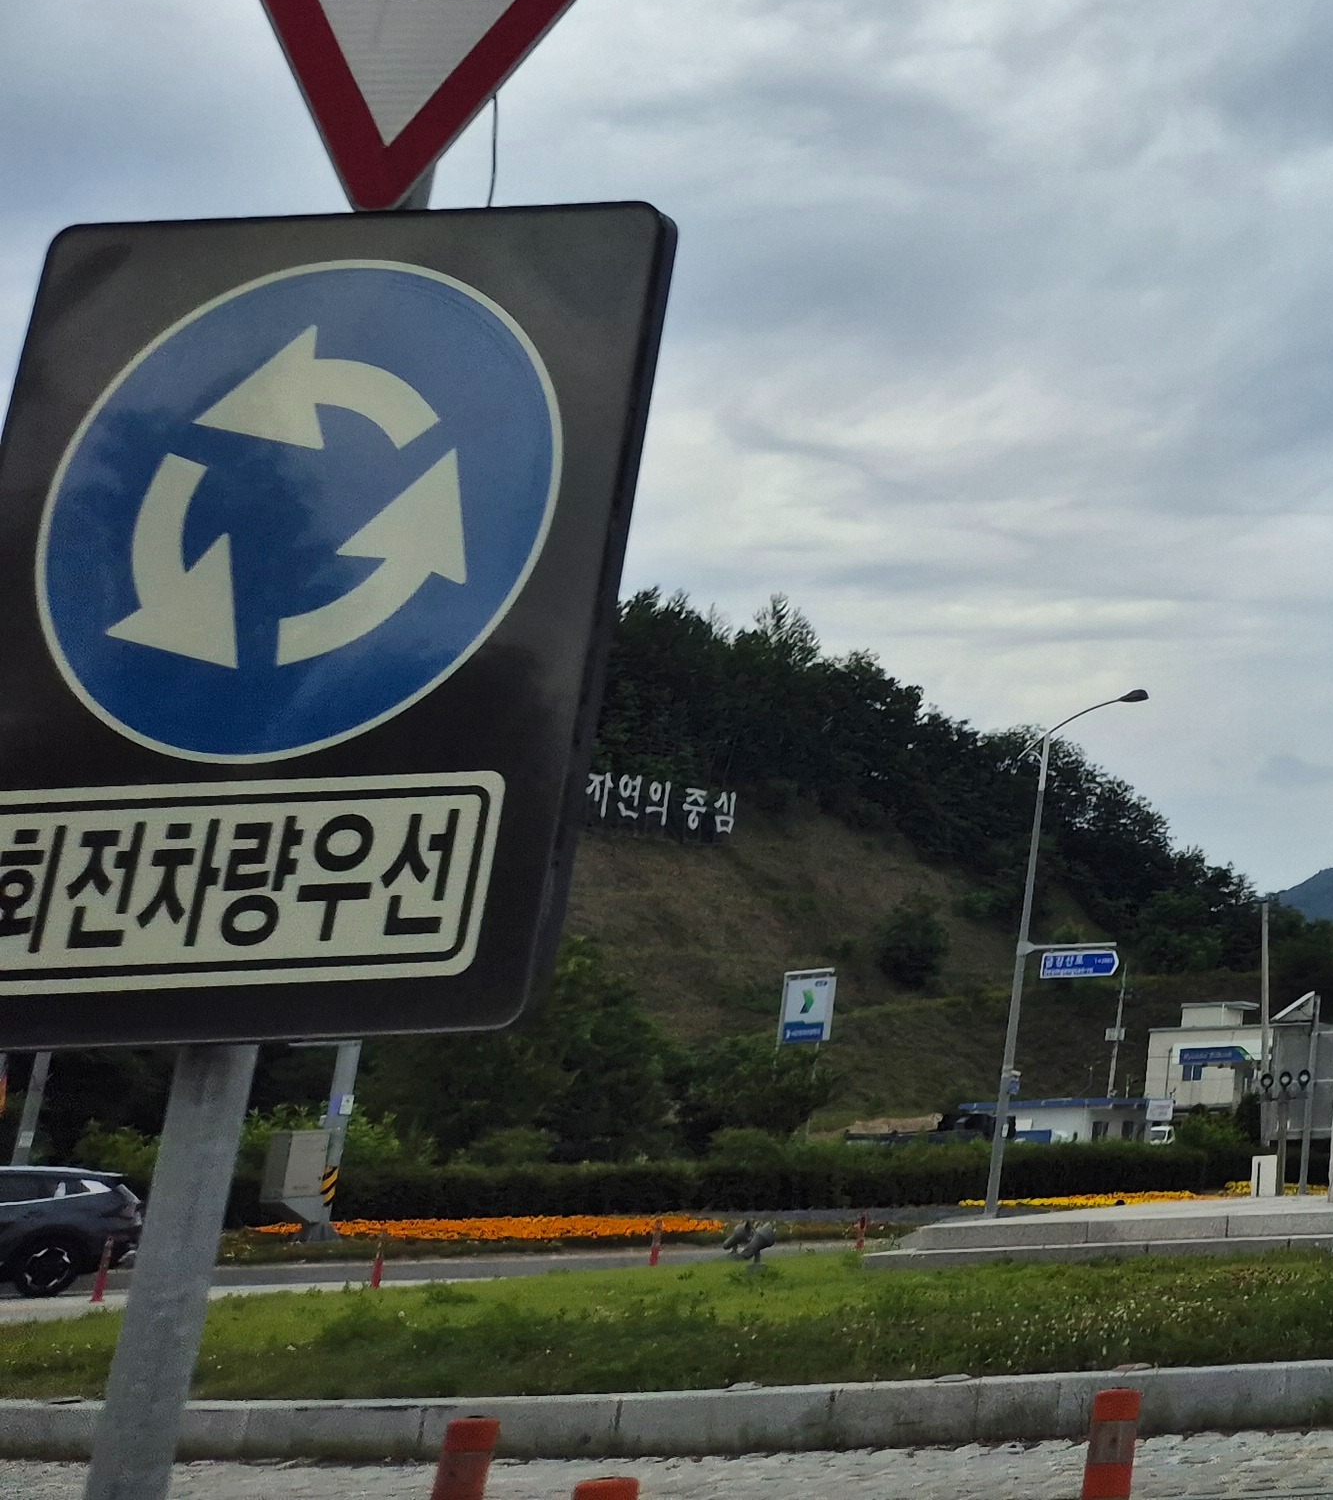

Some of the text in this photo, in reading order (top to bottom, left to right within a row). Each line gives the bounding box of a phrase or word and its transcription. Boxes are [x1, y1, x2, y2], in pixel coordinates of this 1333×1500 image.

[585, 771, 737, 835] 자연의 중심
[0, 808, 462, 954] 회전차량우선
